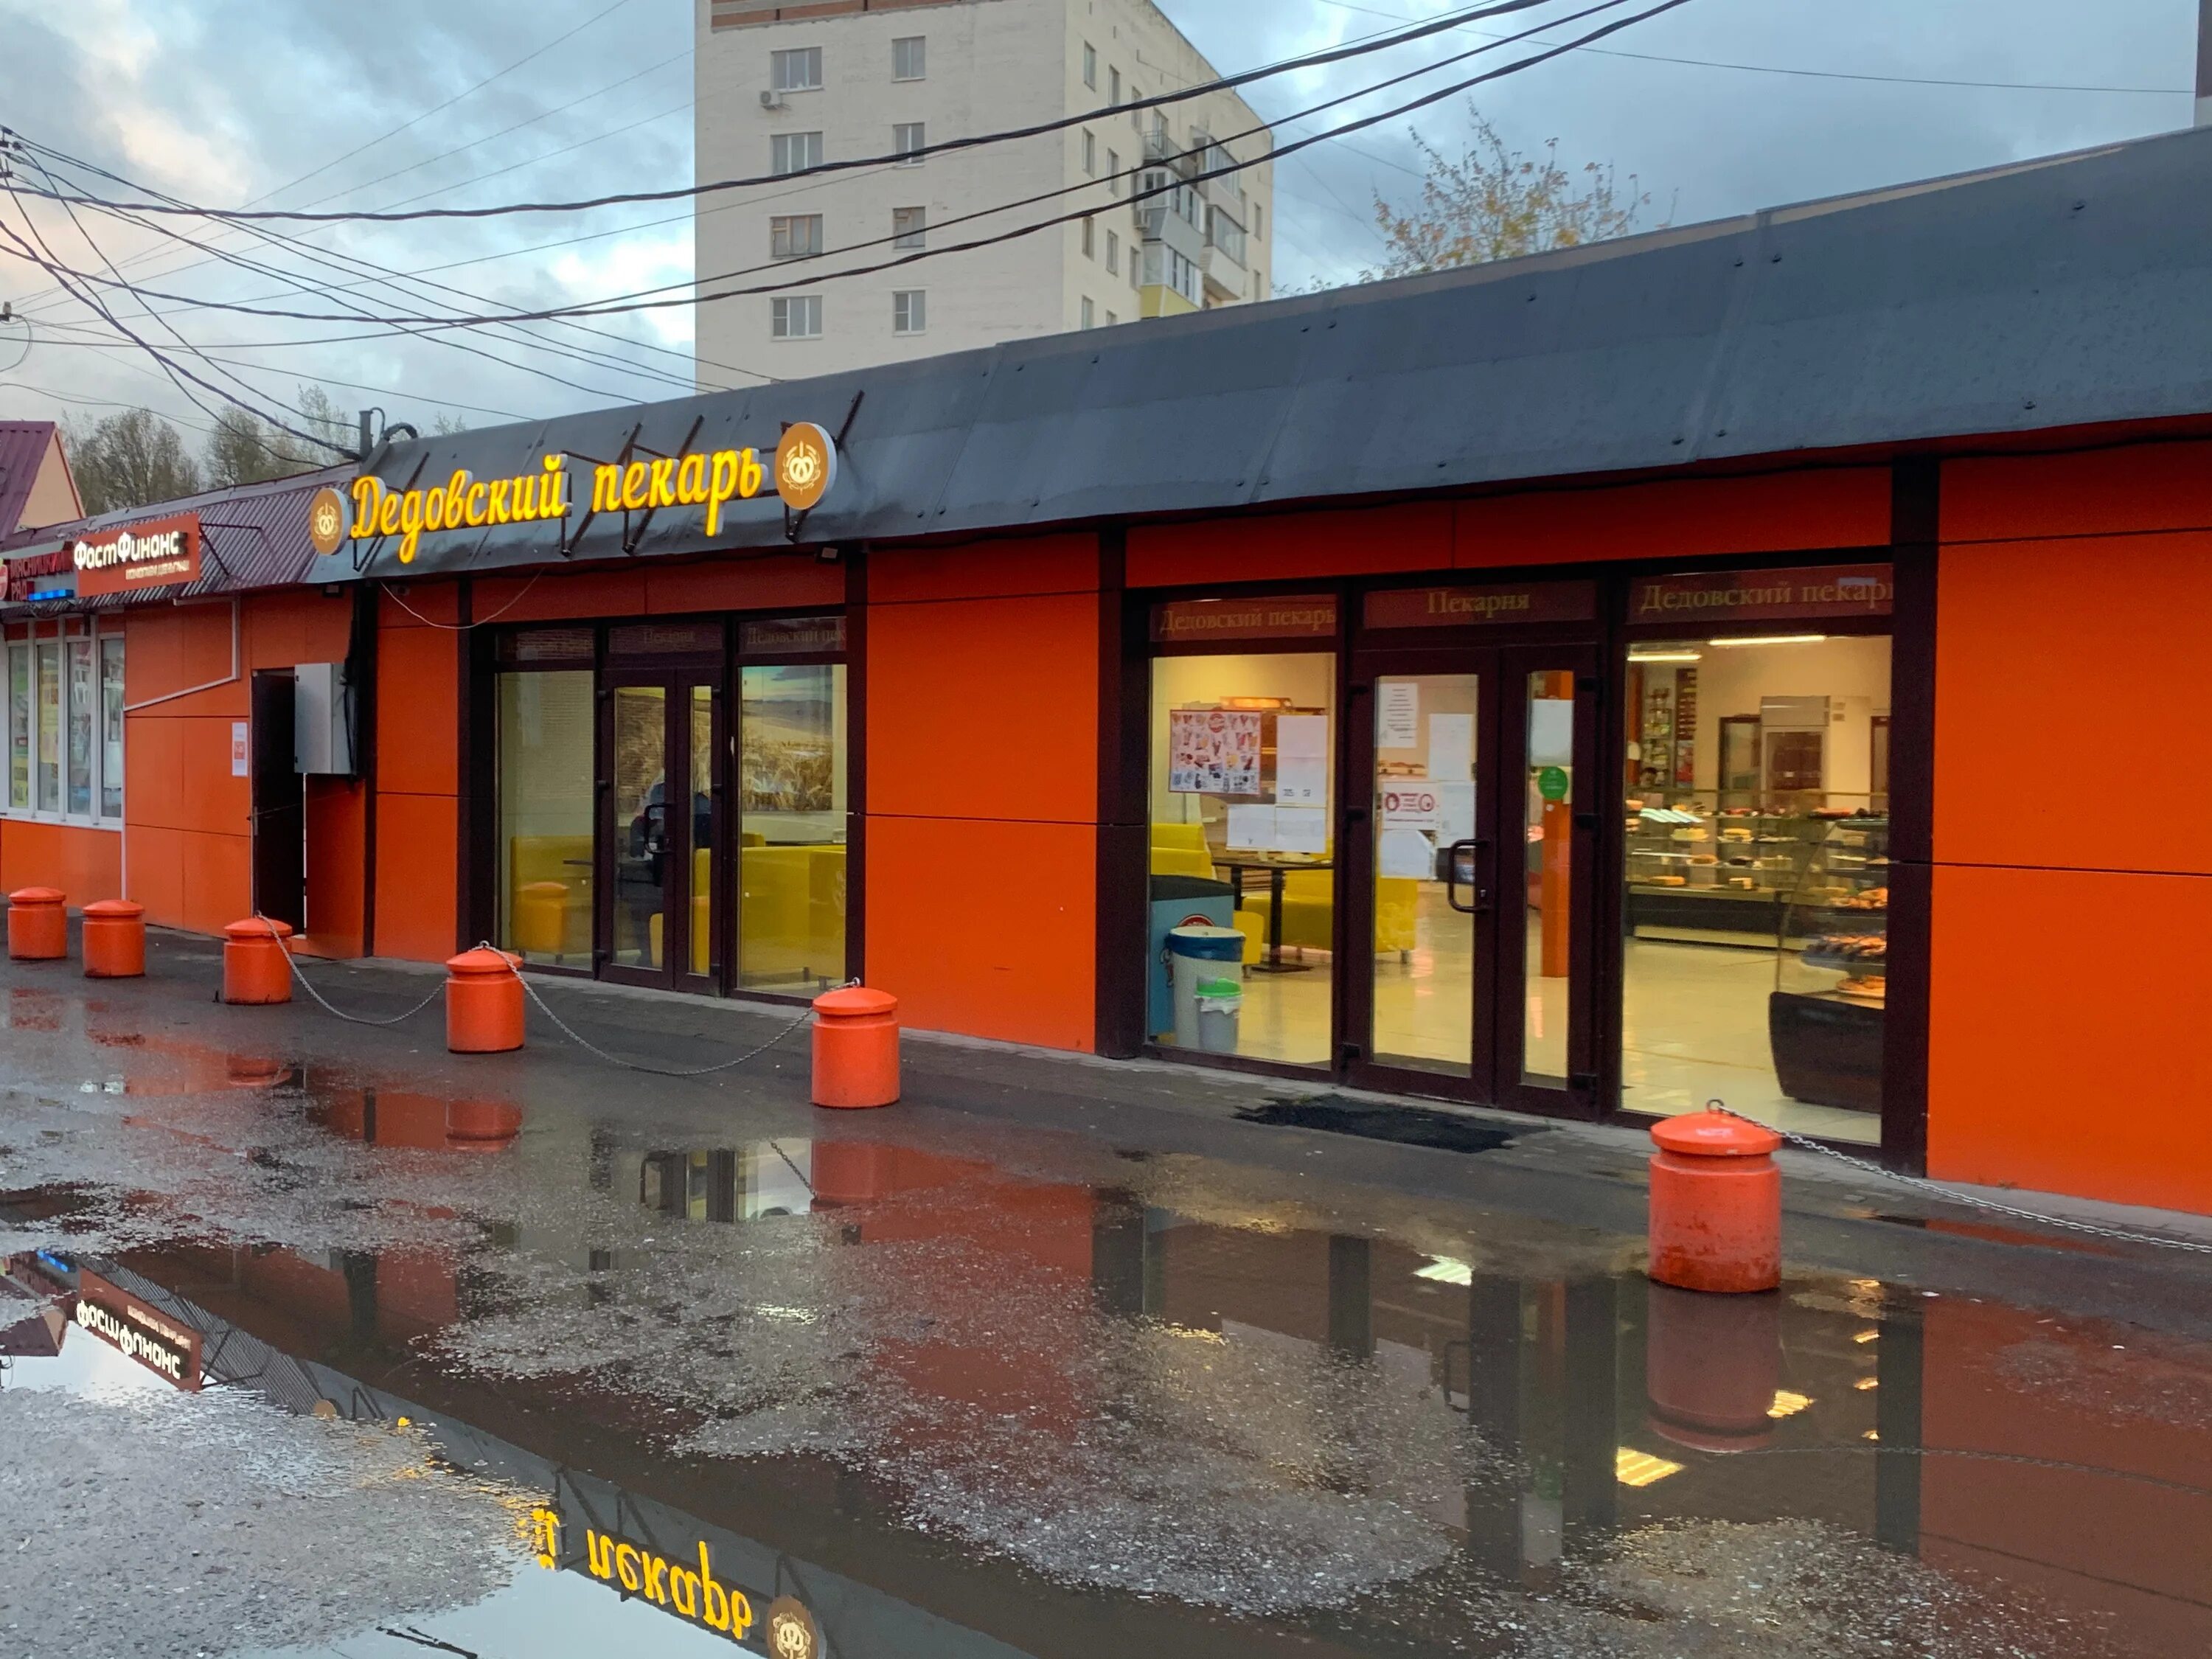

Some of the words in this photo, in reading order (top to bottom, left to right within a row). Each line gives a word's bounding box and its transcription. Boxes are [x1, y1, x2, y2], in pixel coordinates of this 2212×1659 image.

[349, 453, 568, 564] Дедовский
[592, 447, 764, 537] пекарь
[74, 531, 180, 570] ФастФинанс
[1427, 591, 1530, 618] Пекарня
[1638, 581, 1792, 613] Дедовский
[1160, 608, 1262, 634] Дедовский
